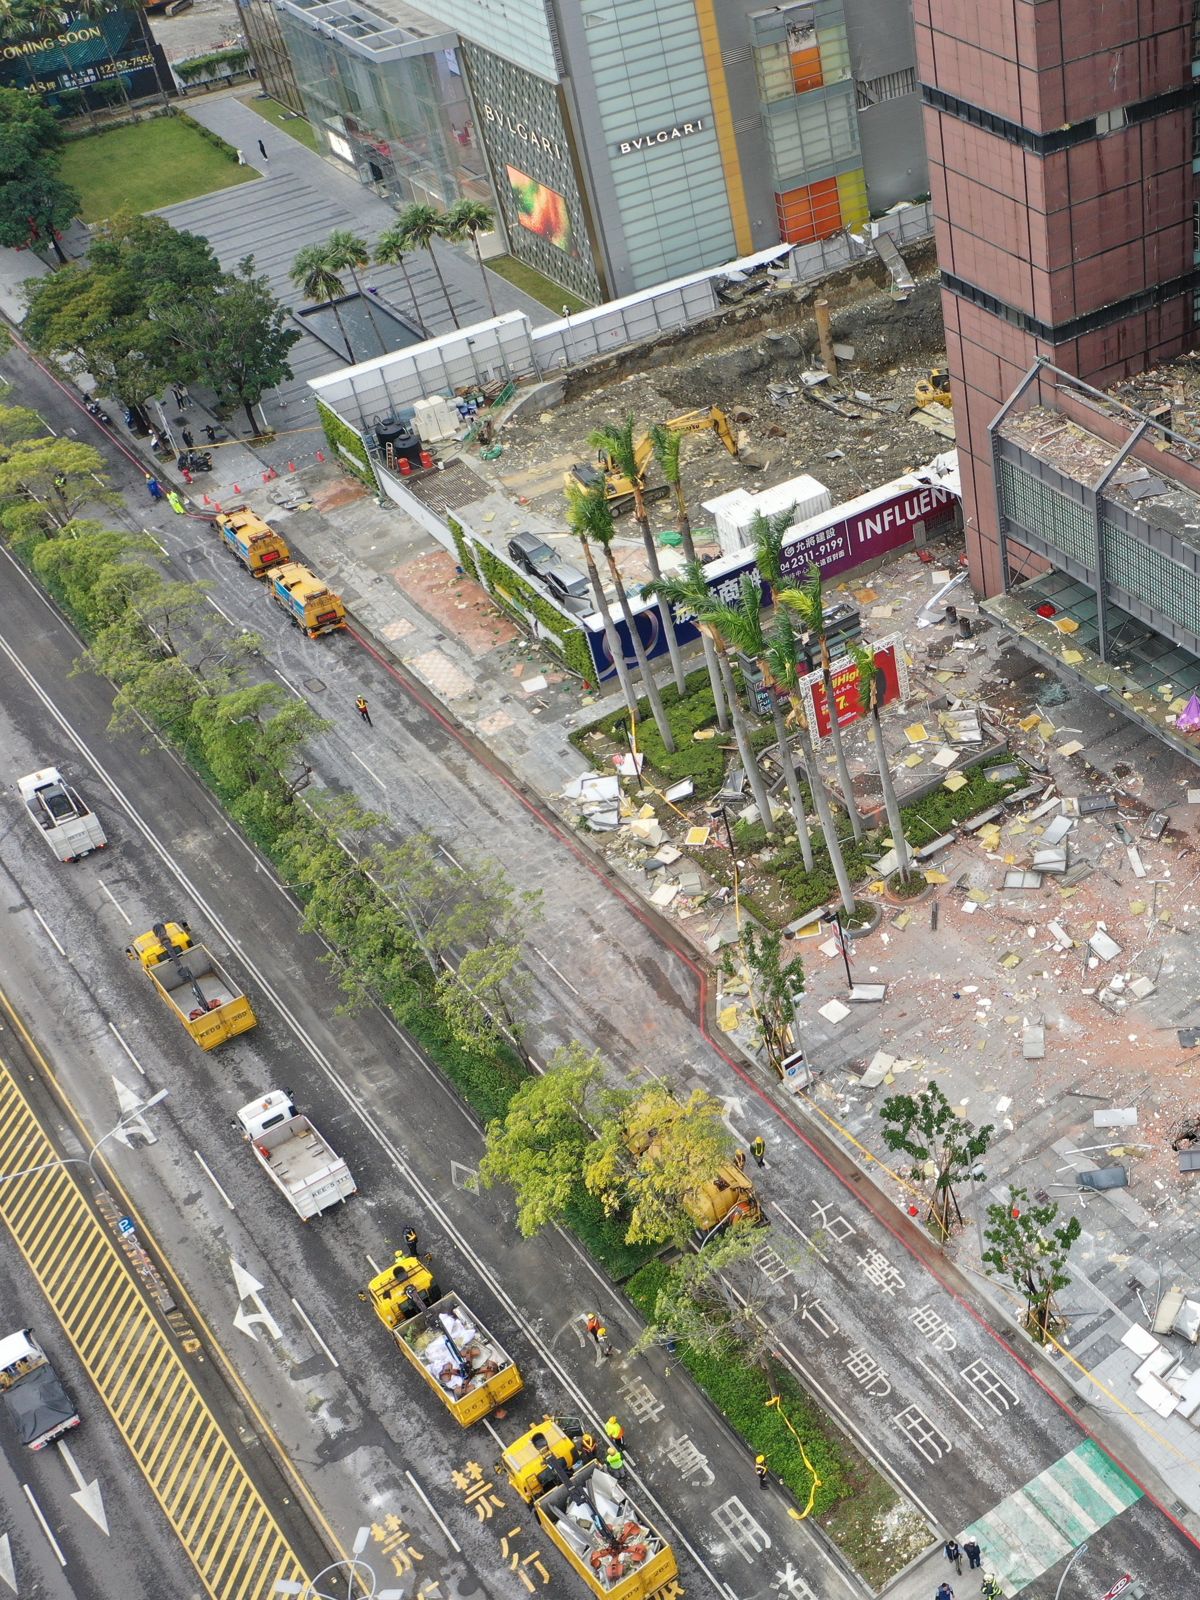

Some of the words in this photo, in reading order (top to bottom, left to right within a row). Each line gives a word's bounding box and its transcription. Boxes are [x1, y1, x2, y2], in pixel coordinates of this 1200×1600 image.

[57, 26, 101, 47] SOON
[484, 104, 562, 160] BVLGARI
[620, 120, 703, 154] BVLGARI
[791, 537, 843, 569] 2311-9199
[811, 1199, 1020, 1416] 右轉專用
[451, 1460, 551, 1593] 禁行
